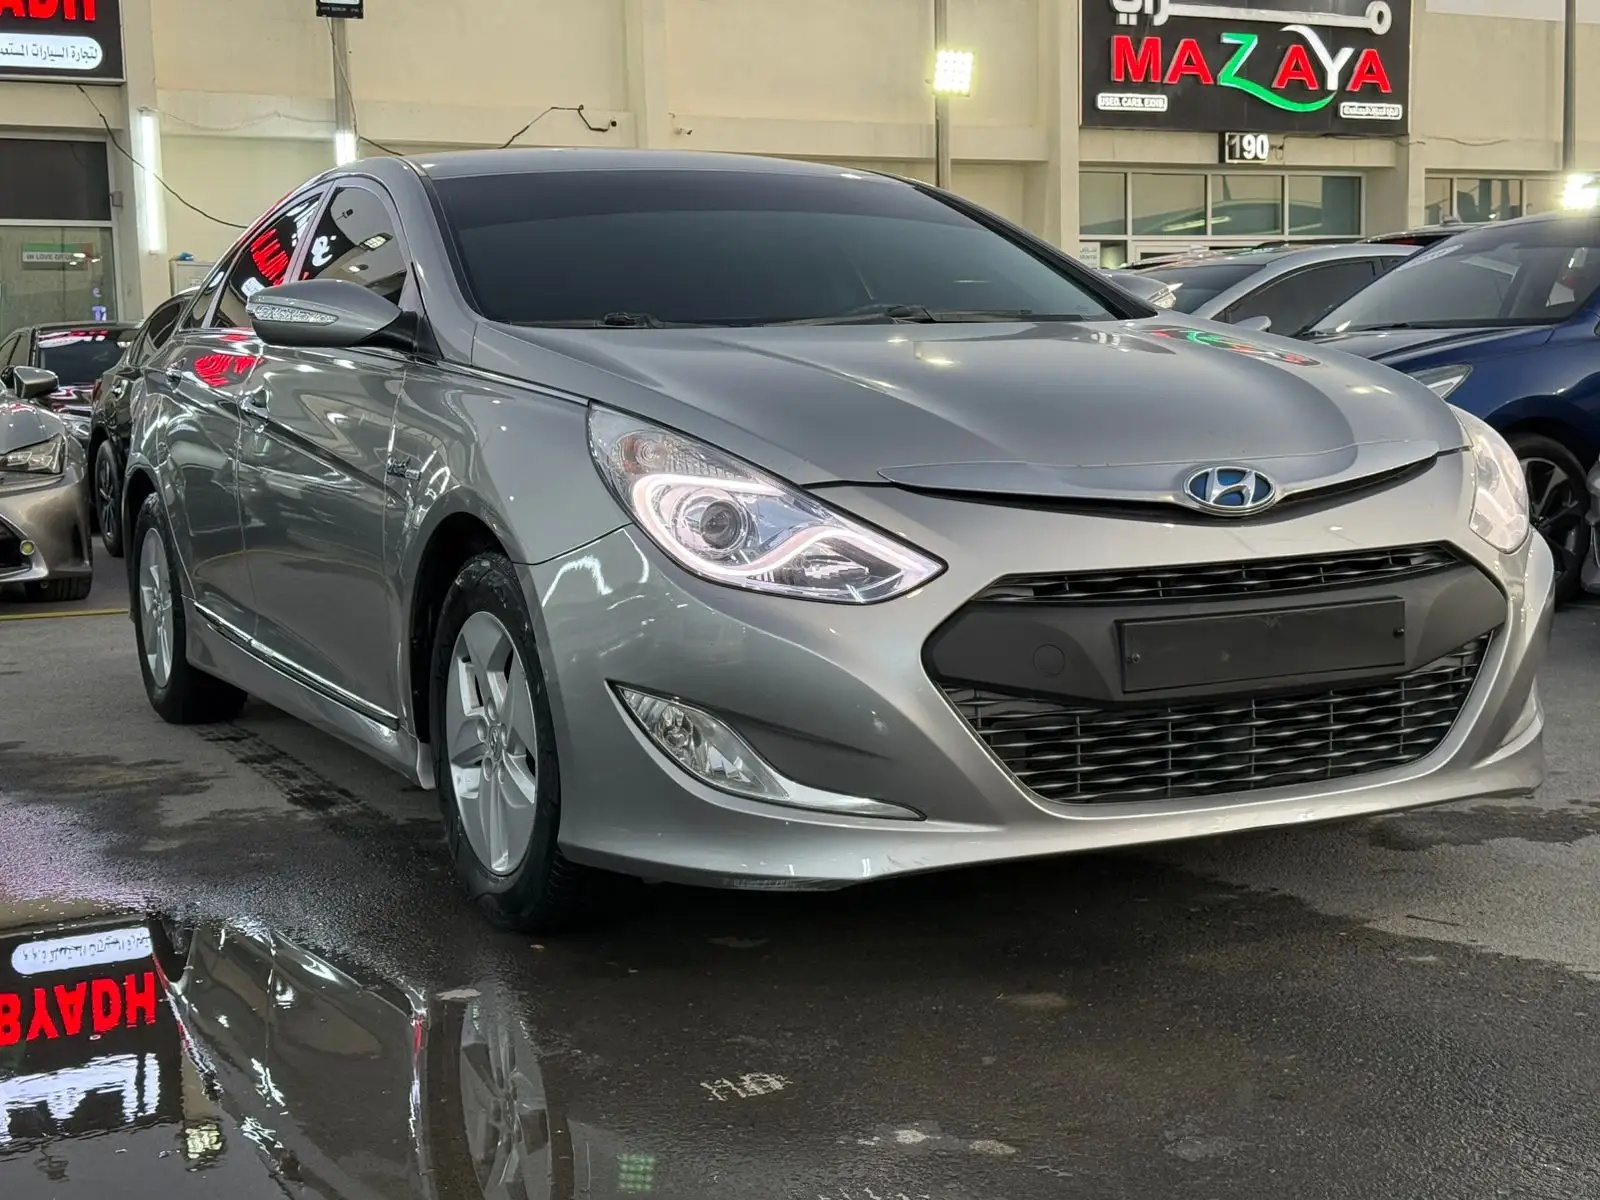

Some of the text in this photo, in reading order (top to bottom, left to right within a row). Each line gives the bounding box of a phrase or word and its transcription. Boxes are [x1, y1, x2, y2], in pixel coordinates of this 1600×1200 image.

[0, 42, 29, 57] المستع
[32, 43, 69, 62] السيارات
[1111, 24, 1392, 113] MAZAYA
[1230, 134, 1269, 160] 190
